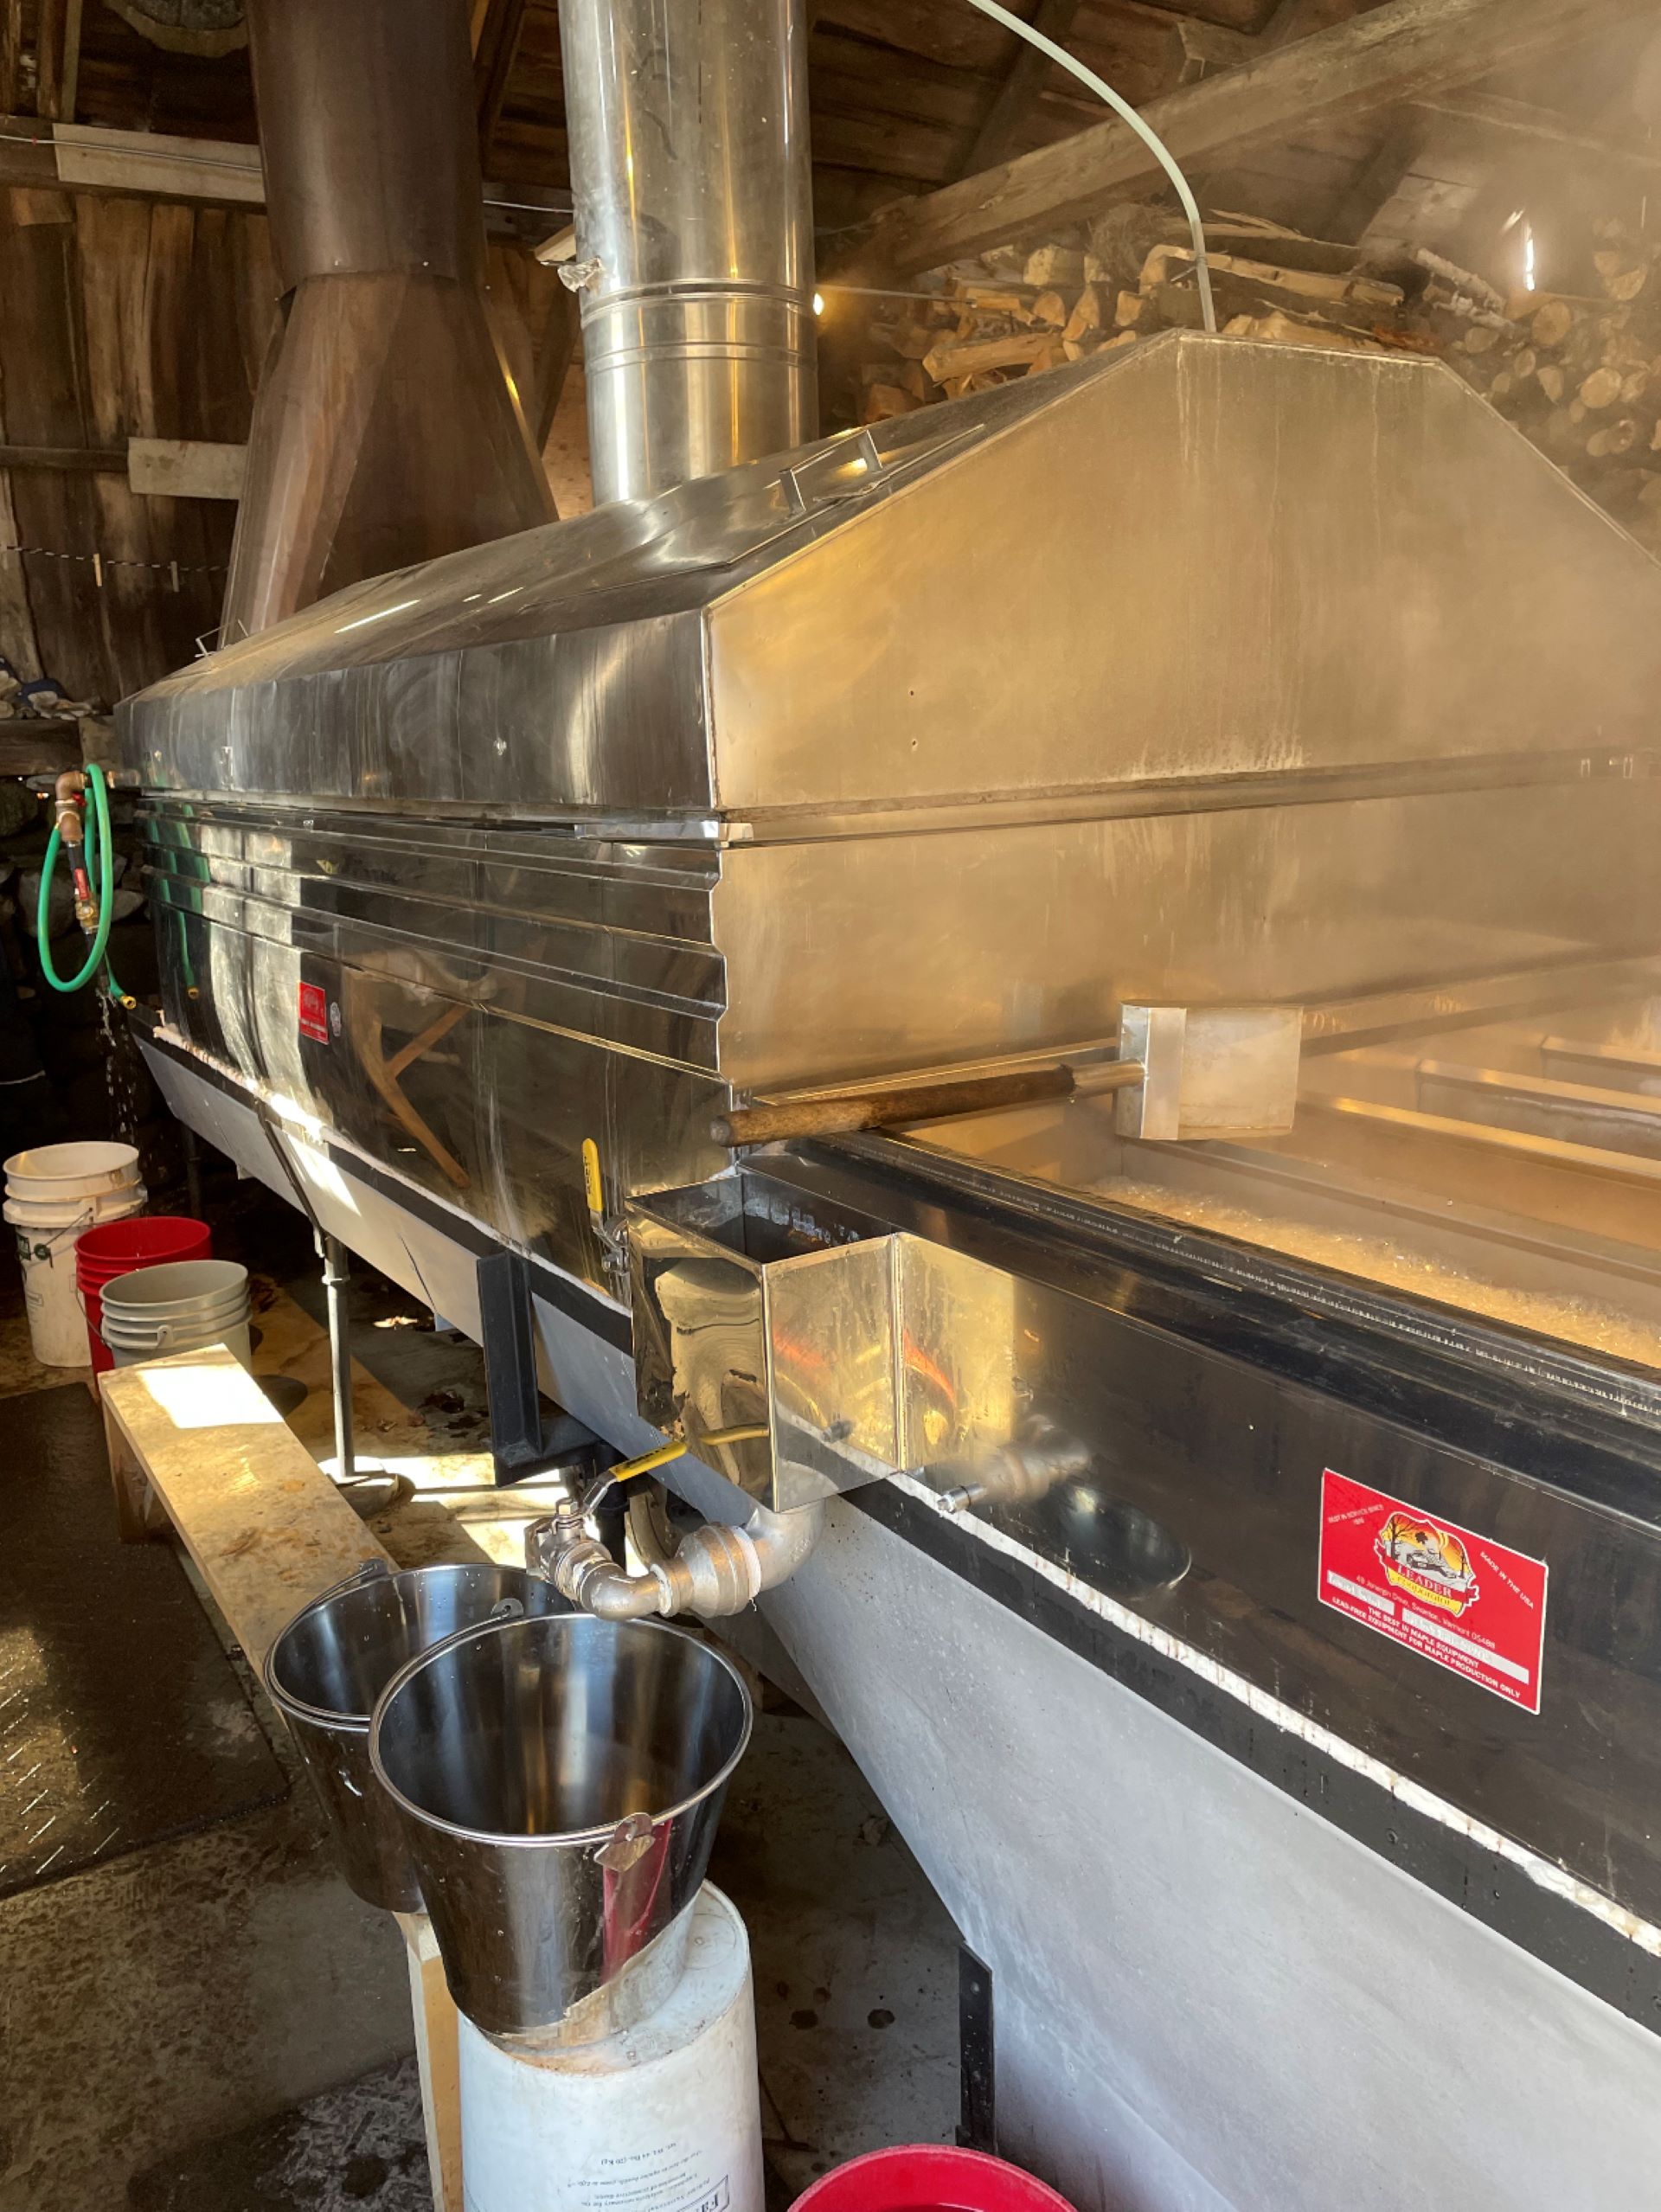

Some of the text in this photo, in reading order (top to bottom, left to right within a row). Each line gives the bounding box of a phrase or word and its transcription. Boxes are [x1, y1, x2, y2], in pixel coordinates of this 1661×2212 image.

[1397, 1564, 1453, 1600] LEADER
[1480, 1551, 1534, 1610] MADE IN THE USA
[1332, 1596, 1521, 1699] LEAD-FREE EQUIPMENT FOR MAPLE PRODUCTION ONLY
[1368, 1606, 1479, 1670] THE BEST IN MAPLE EQUIPMENT
